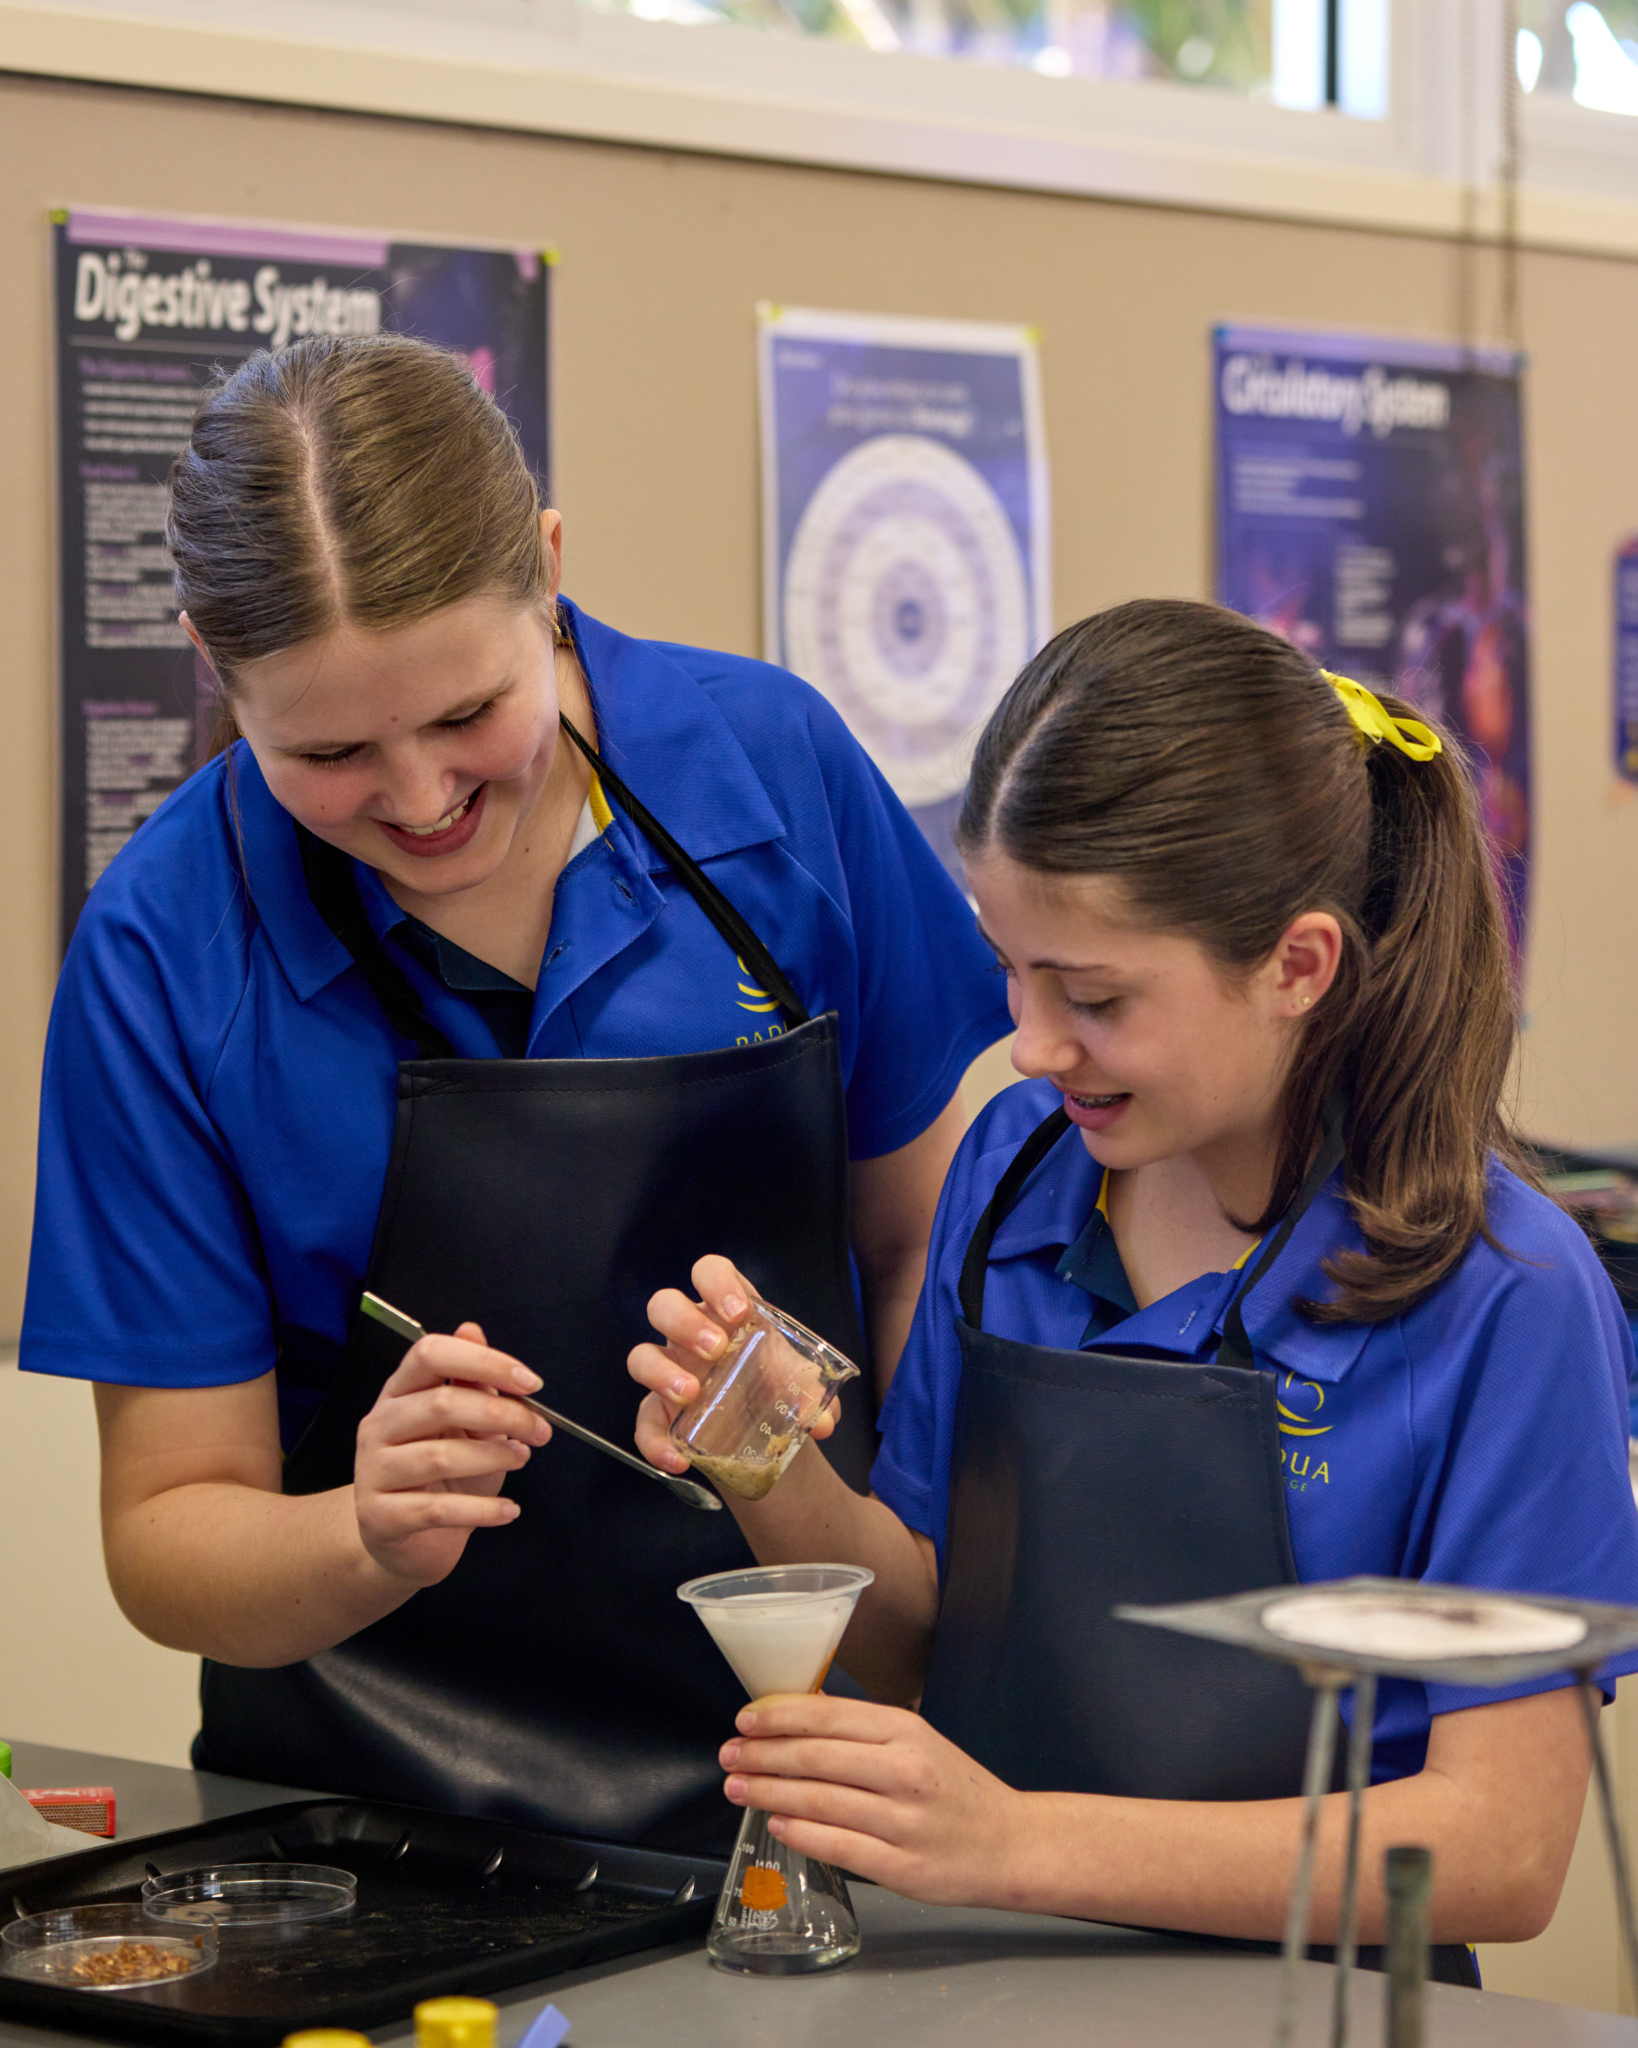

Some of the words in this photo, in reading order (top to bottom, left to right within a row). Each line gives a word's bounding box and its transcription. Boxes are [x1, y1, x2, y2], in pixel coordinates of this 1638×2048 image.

[74, 251, 251, 342] Digestive
[253, 266, 382, 347] System
[736, 1021, 788, 1046] PAD
